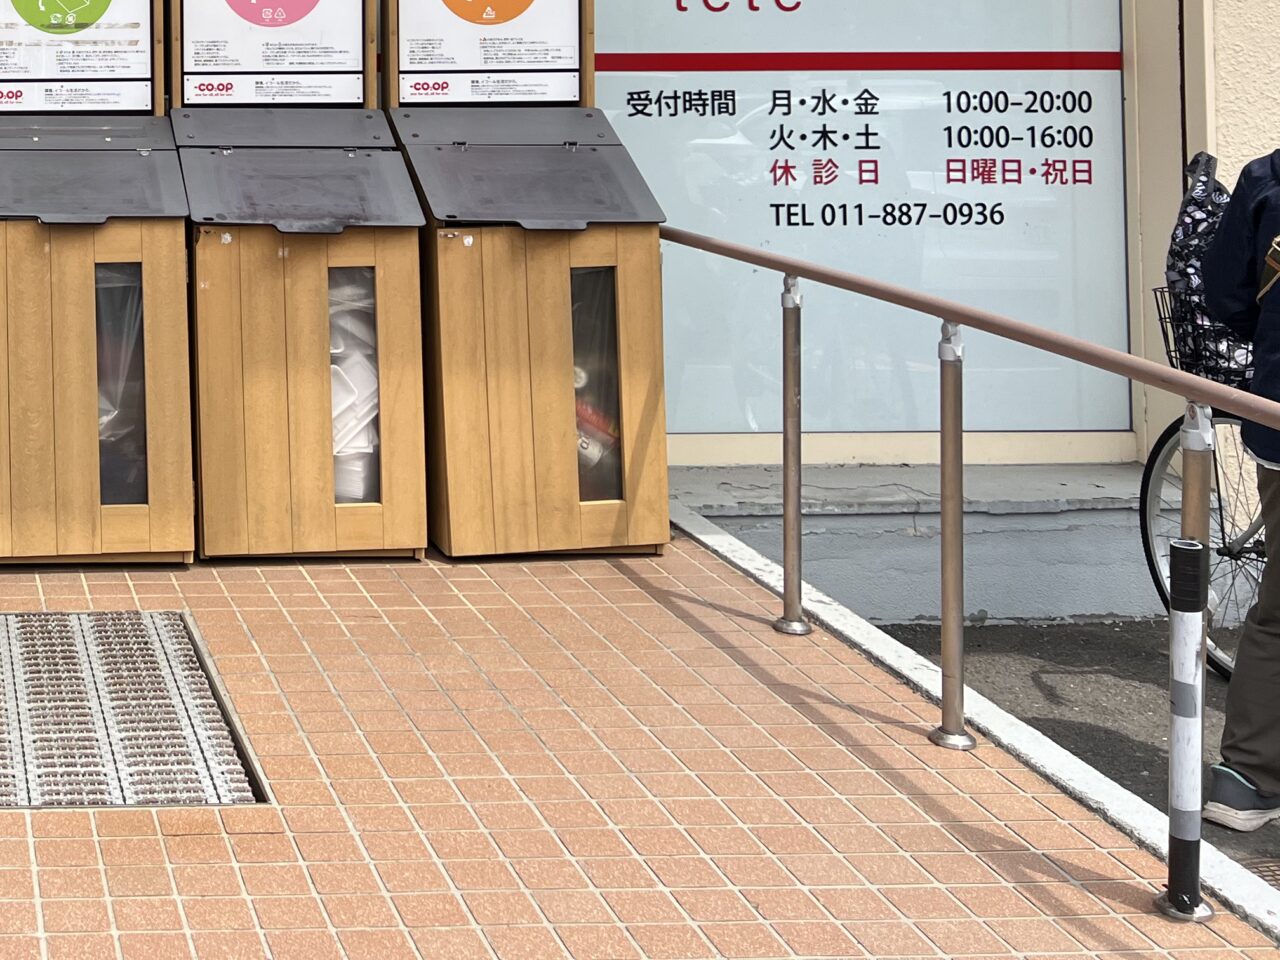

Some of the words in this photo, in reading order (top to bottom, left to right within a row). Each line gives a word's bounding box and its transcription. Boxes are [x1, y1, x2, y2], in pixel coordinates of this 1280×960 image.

[626, 89, 736, 117] 受付時間
[767, 88, 880, 116] 月・水・金
[942, 90, 1093, 114] 10:00-20:00
[768, 124, 881, 151] 火・木・土
[943, 125, 1094, 149] 10:00-16:00
[769, 158, 880, 185] 休診日
[945, 158, 1094, 185] 日曜日・祝日
[770, 203, 815, 227] TEL
[821, 203, 1005, 227] 011-887-0936
